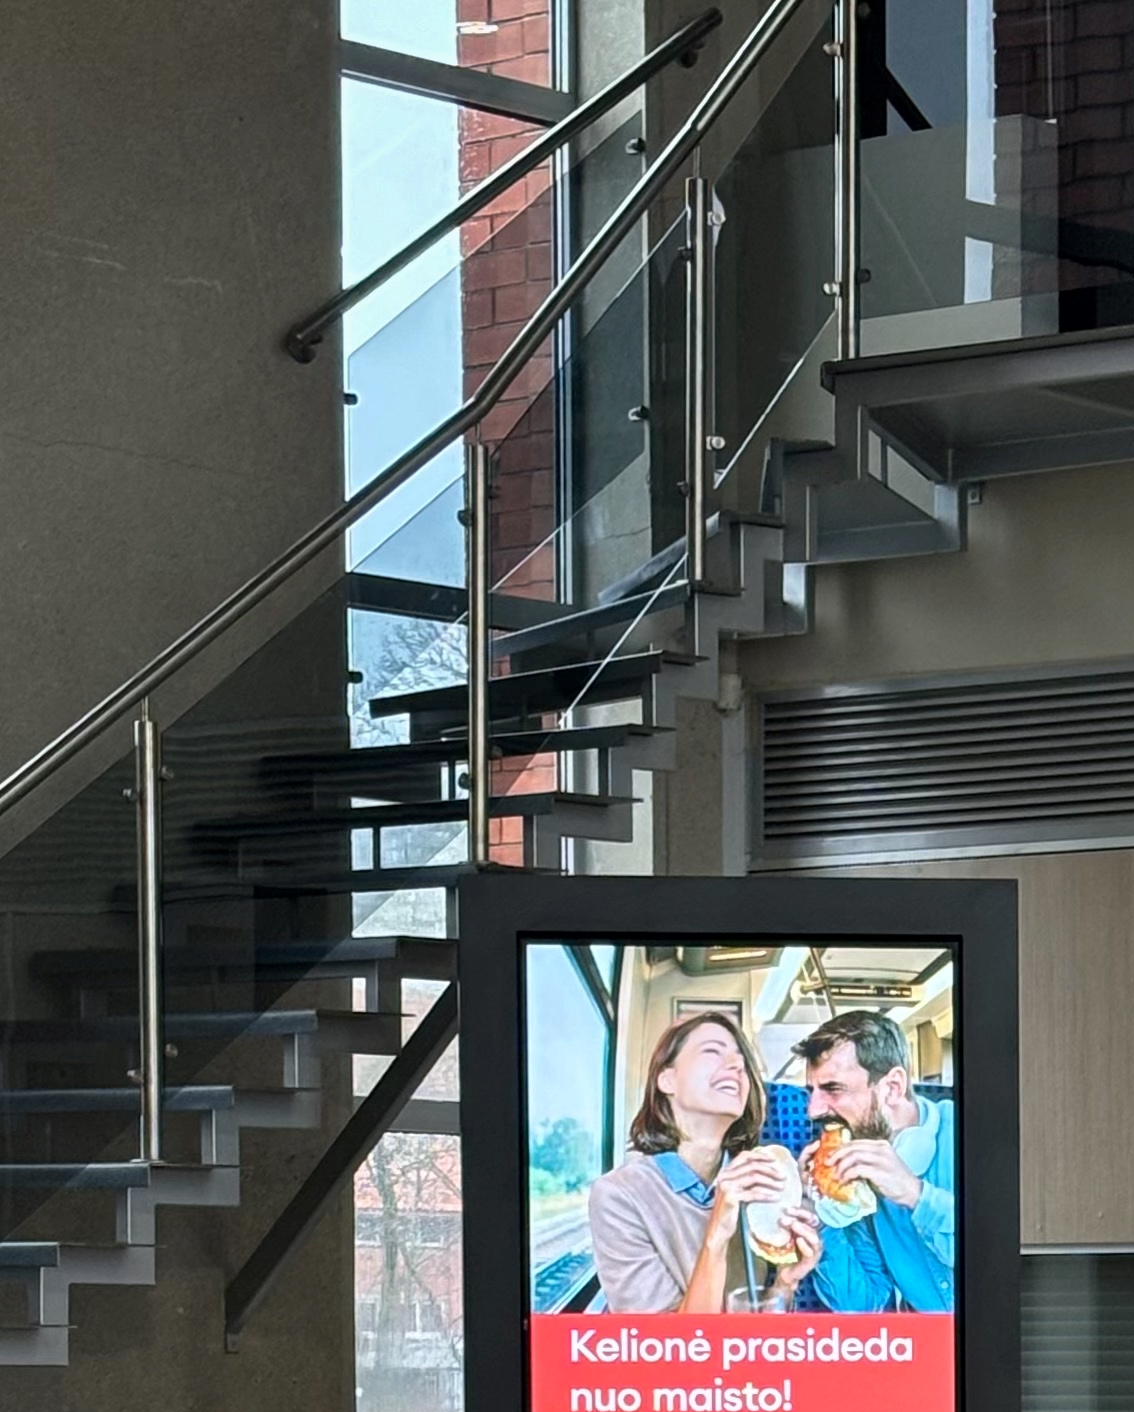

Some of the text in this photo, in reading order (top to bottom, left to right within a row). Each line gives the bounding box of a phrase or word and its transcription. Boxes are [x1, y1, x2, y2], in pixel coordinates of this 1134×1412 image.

[569, 1327, 914, 1371] Kelionė prasideda
[569, 1377, 793, 1412] nuo maisto!
